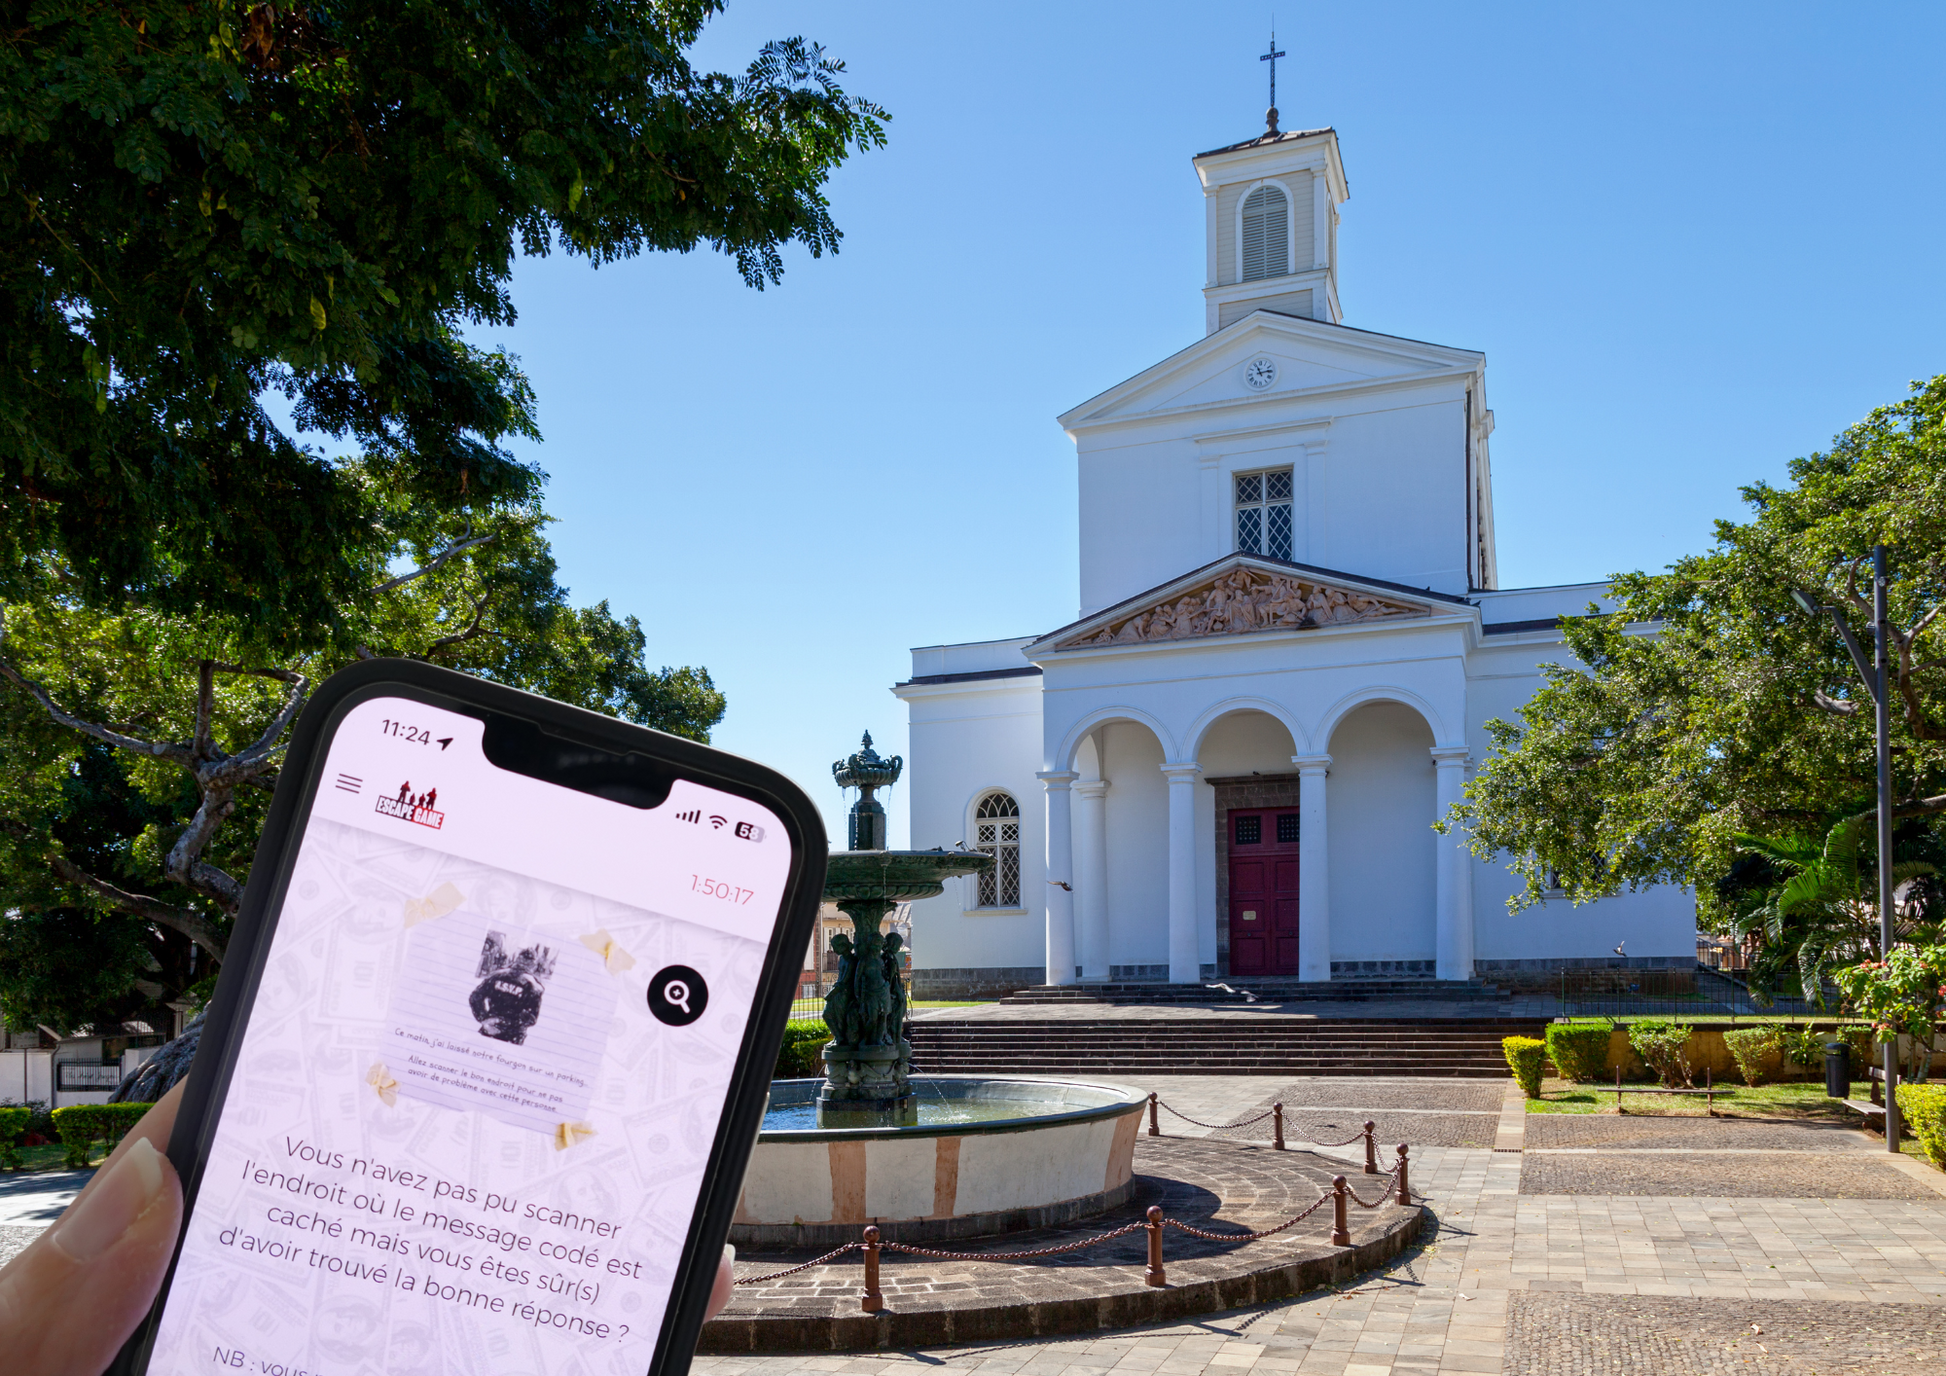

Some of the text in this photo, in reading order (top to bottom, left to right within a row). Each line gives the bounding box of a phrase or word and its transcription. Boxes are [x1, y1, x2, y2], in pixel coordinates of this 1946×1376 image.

[382, 719, 431, 745] 11:24
[376, 796, 443, 827] ESCAPE GAME
[739, 824, 760, 840] 58
[692, 874, 754, 905] 1:50:17
[395, 1027, 405, 1038] Ce
[430, 1038, 445, 1049] j'ai
[447, 1041, 470, 1054] laissé
[473, 1050, 494, 1061] notre
[496, 1054, 527, 1070] fourgon
[529, 1065, 543, 1074] sur
[407, 1067, 428, 1079] avoir
[430, 1071, 440, 1082] de
[441, 1075, 478, 1093] problème
[480, 1086, 497, 1098] avec
[499, 1091, 519, 1103] cette
[408, 1055, 563, 1103] Allez scanner le bon endroit pour ne pas
[286, 1136, 622, 1239] Vous n'avez pas pu scanner
[242, 1159, 643, 1279] l'endroit où le message codé est
[267, 1207, 600, 1306] caché mais vous êtes sûr(s)
[219, 1226, 630, 1343] d'avoir trouvé la bonne réponse ?
[213, 1346, 246, 1368] NB
